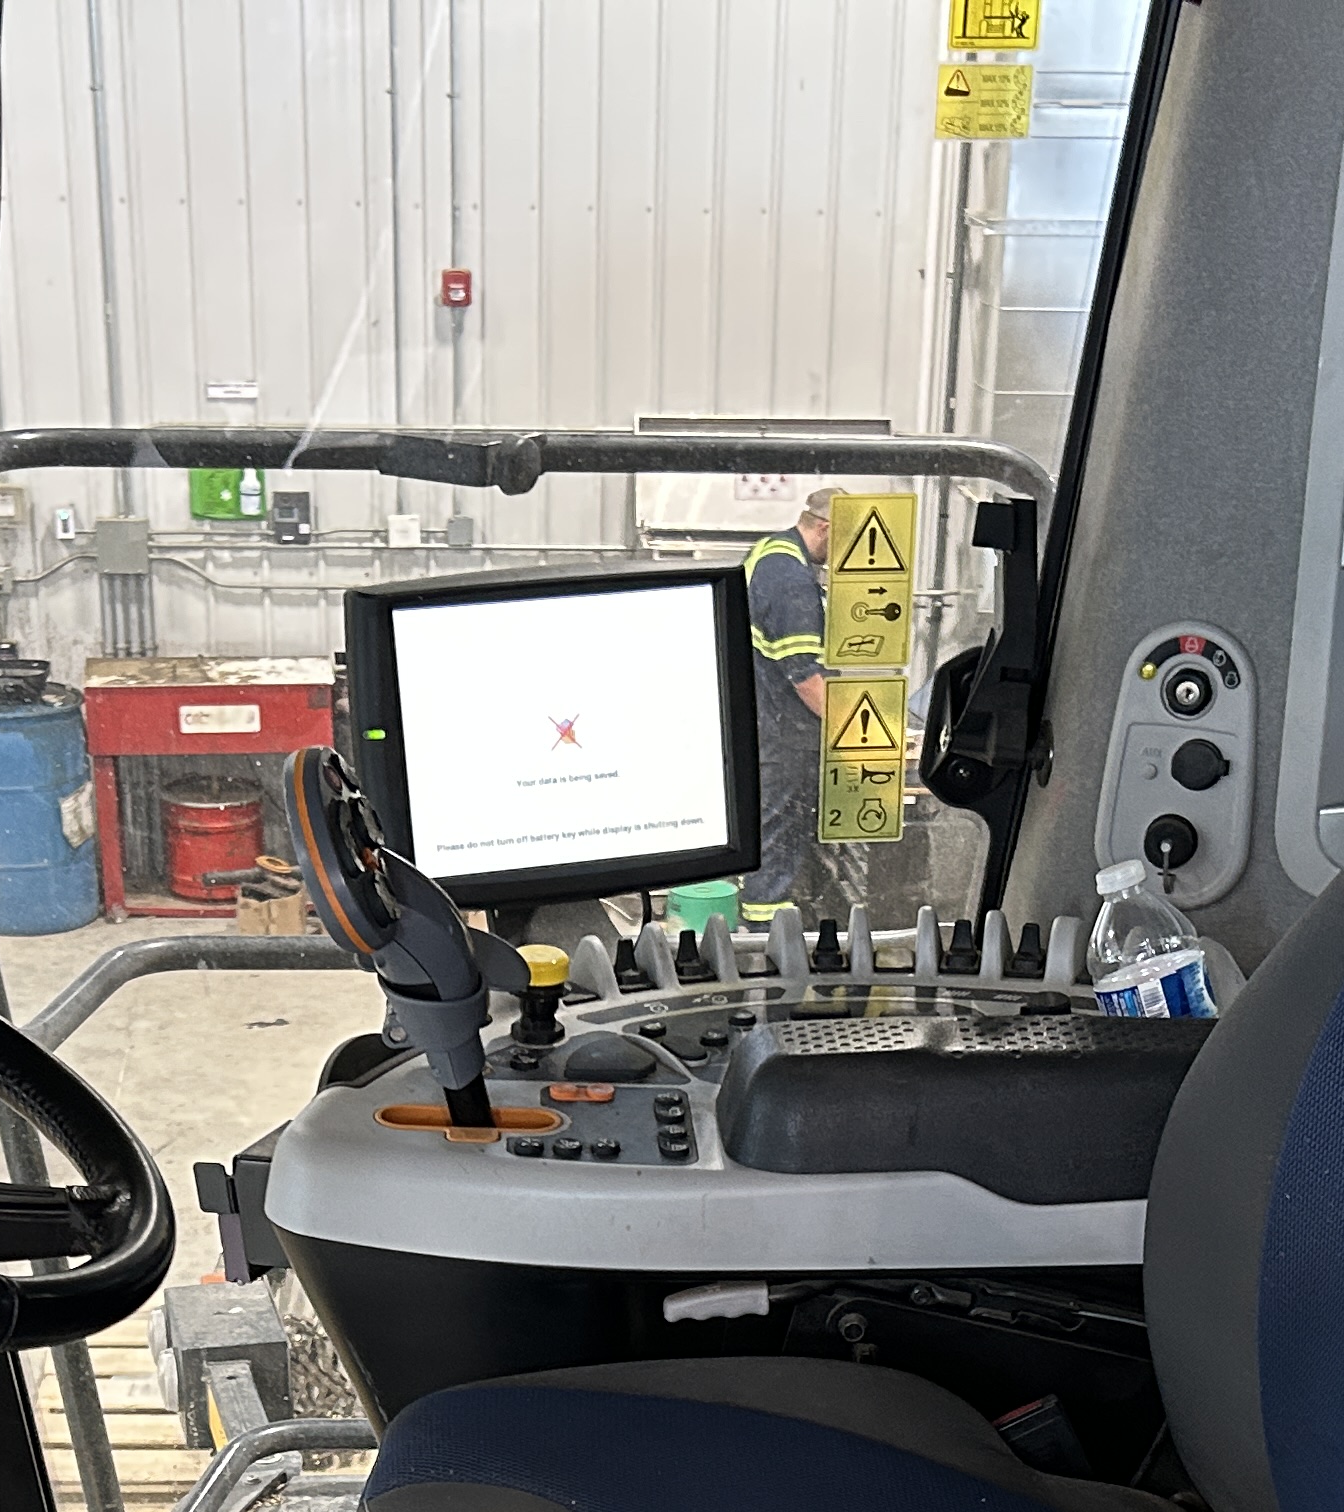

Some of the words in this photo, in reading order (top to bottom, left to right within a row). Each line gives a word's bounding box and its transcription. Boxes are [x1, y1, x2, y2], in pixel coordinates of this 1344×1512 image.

[539, 777, 558, 785] data
[569, 774, 591, 783] being
[829, 768, 838, 786] 1
[829, 809, 842, 827] 2
[436, 843, 465, 852] Please
[467, 841, 478, 849] do
[480, 839, 495, 847] not
[497, 837, 515, 846] turn
[516, 835, 528, 843] off
[530, 833, 560, 842] battery
[562, 831, 576, 840] key
[578, 827, 600, 837] while
[603, 825, 632, 835] display
[634, 823, 642, 831] is
[644, 819, 678, 829] shutting
